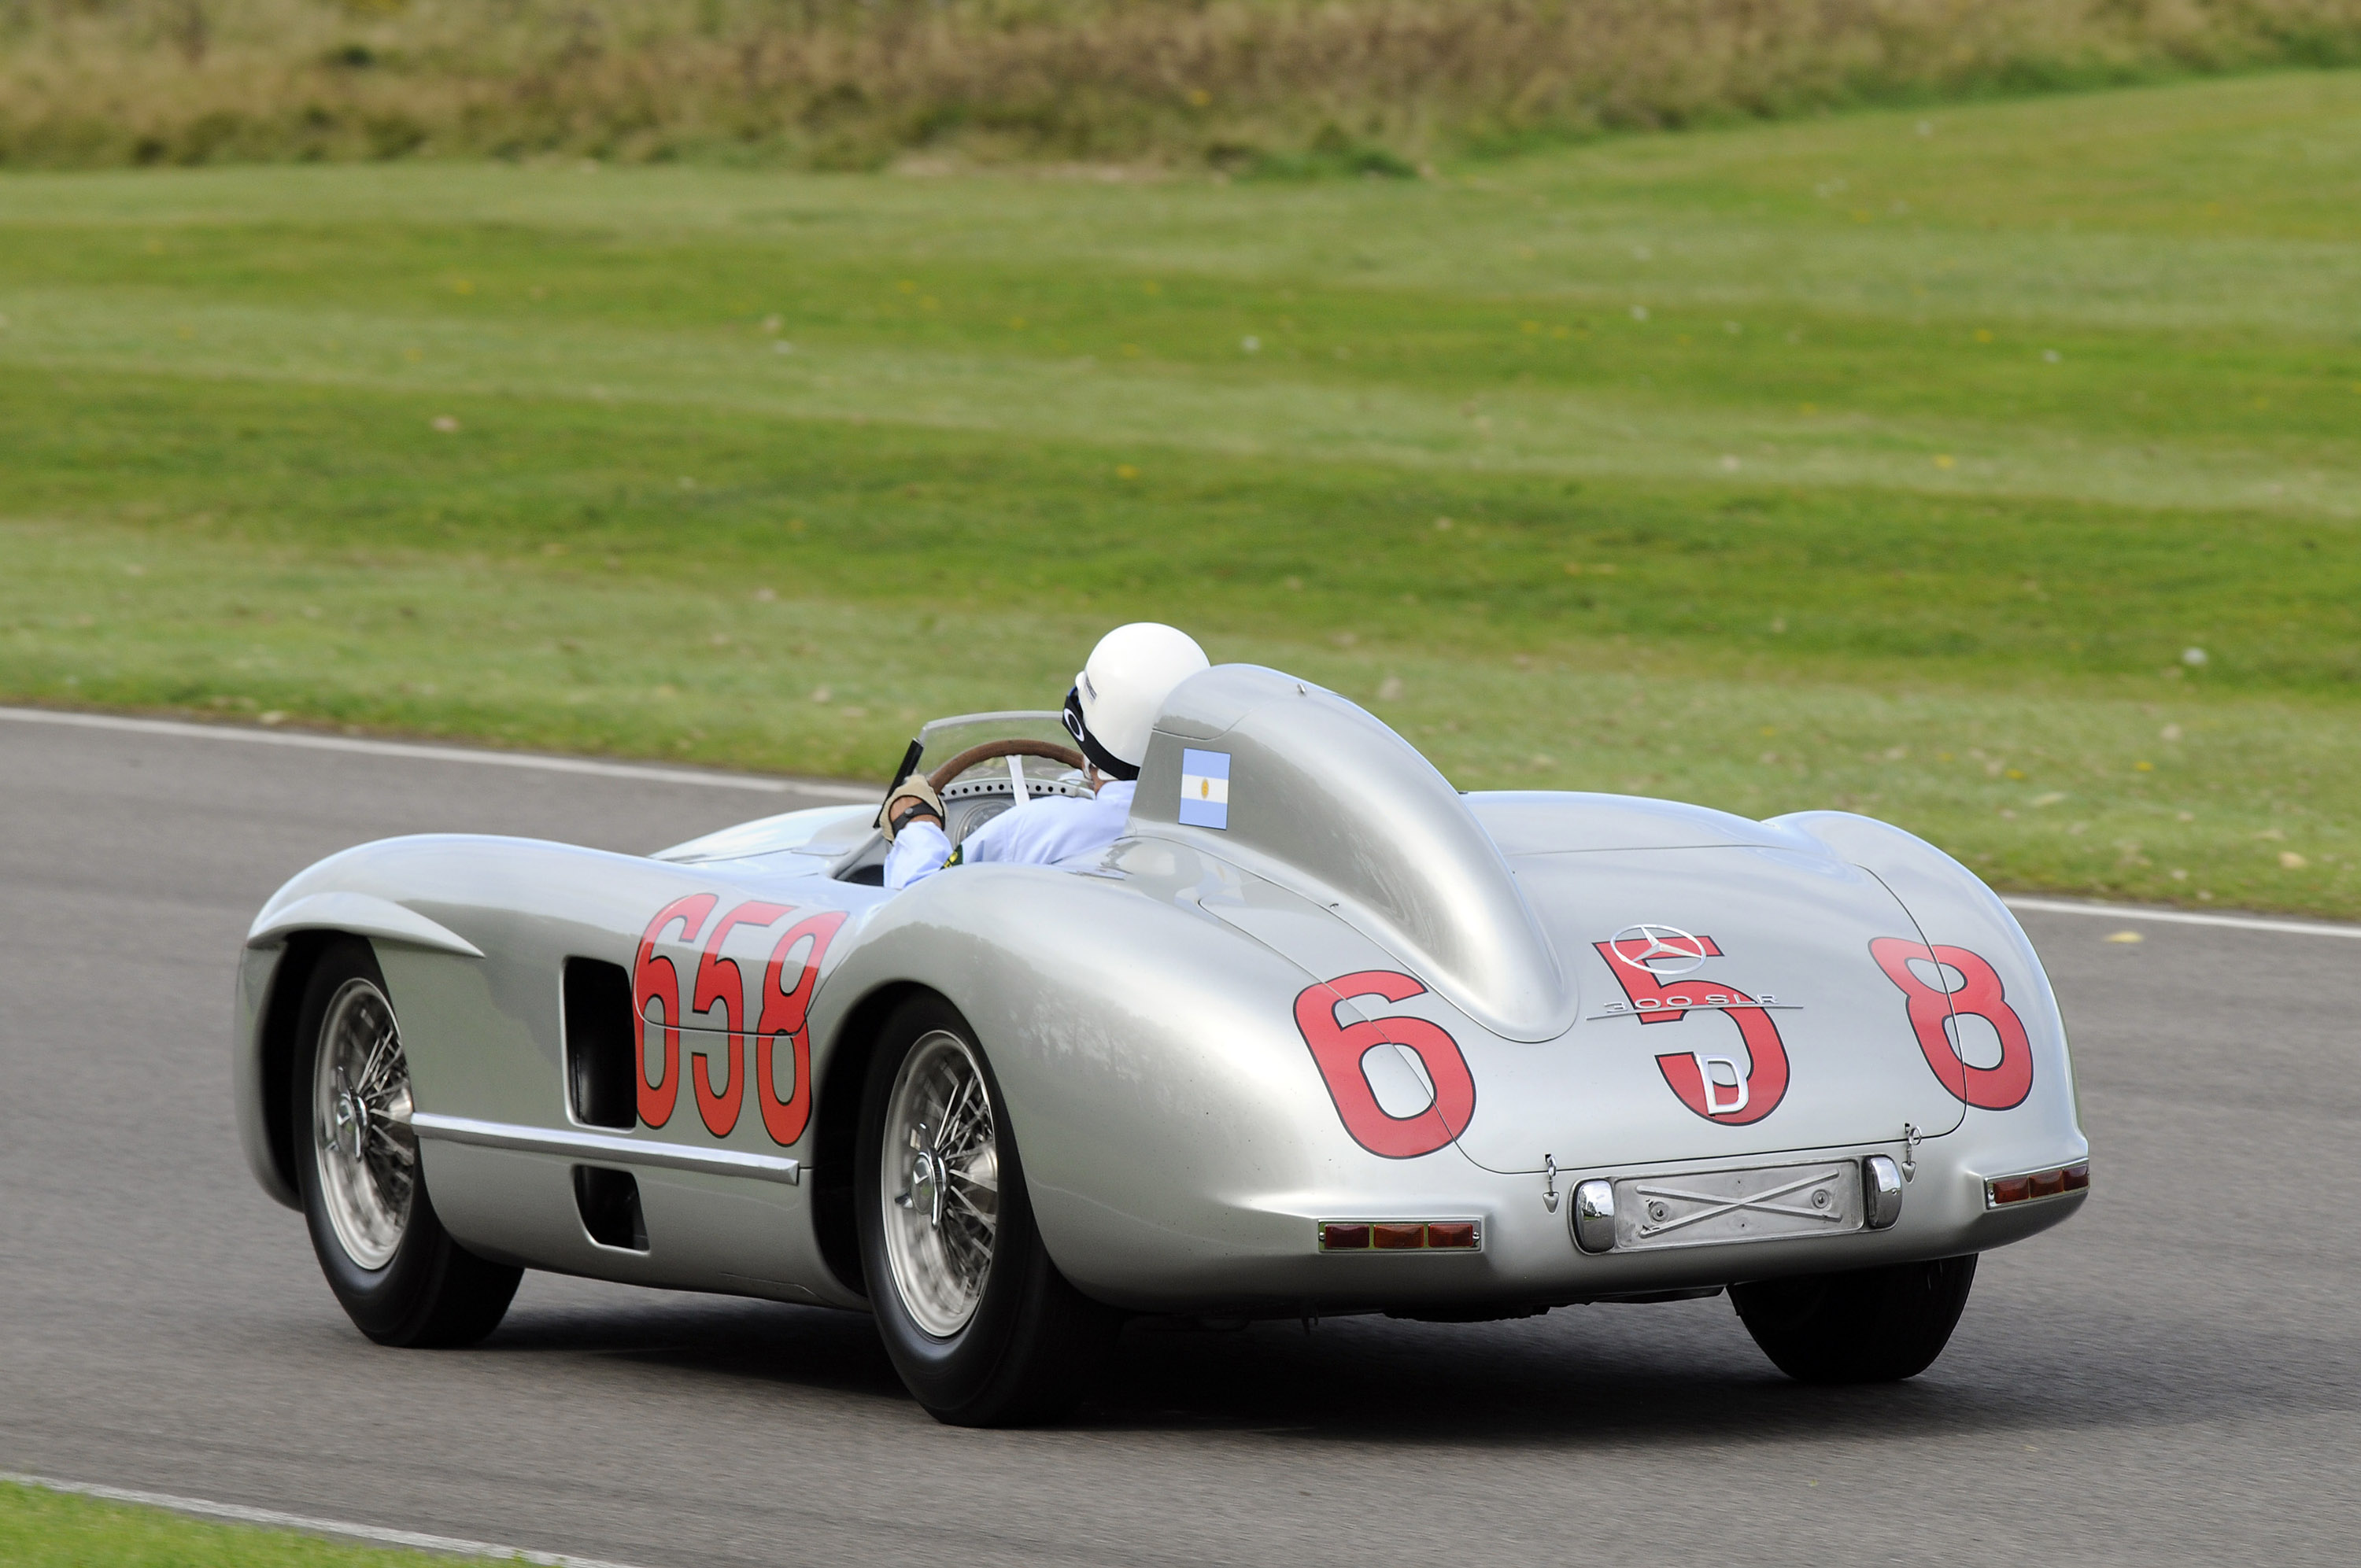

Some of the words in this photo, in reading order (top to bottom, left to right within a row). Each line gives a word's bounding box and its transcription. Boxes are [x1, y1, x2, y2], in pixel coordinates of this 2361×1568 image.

[633, 893, 849, 1146] 658
[1604, 995, 1692, 1013] 300
[1705, 993, 1779, 1005] SLR
[1696, 1053, 1749, 1114] D
